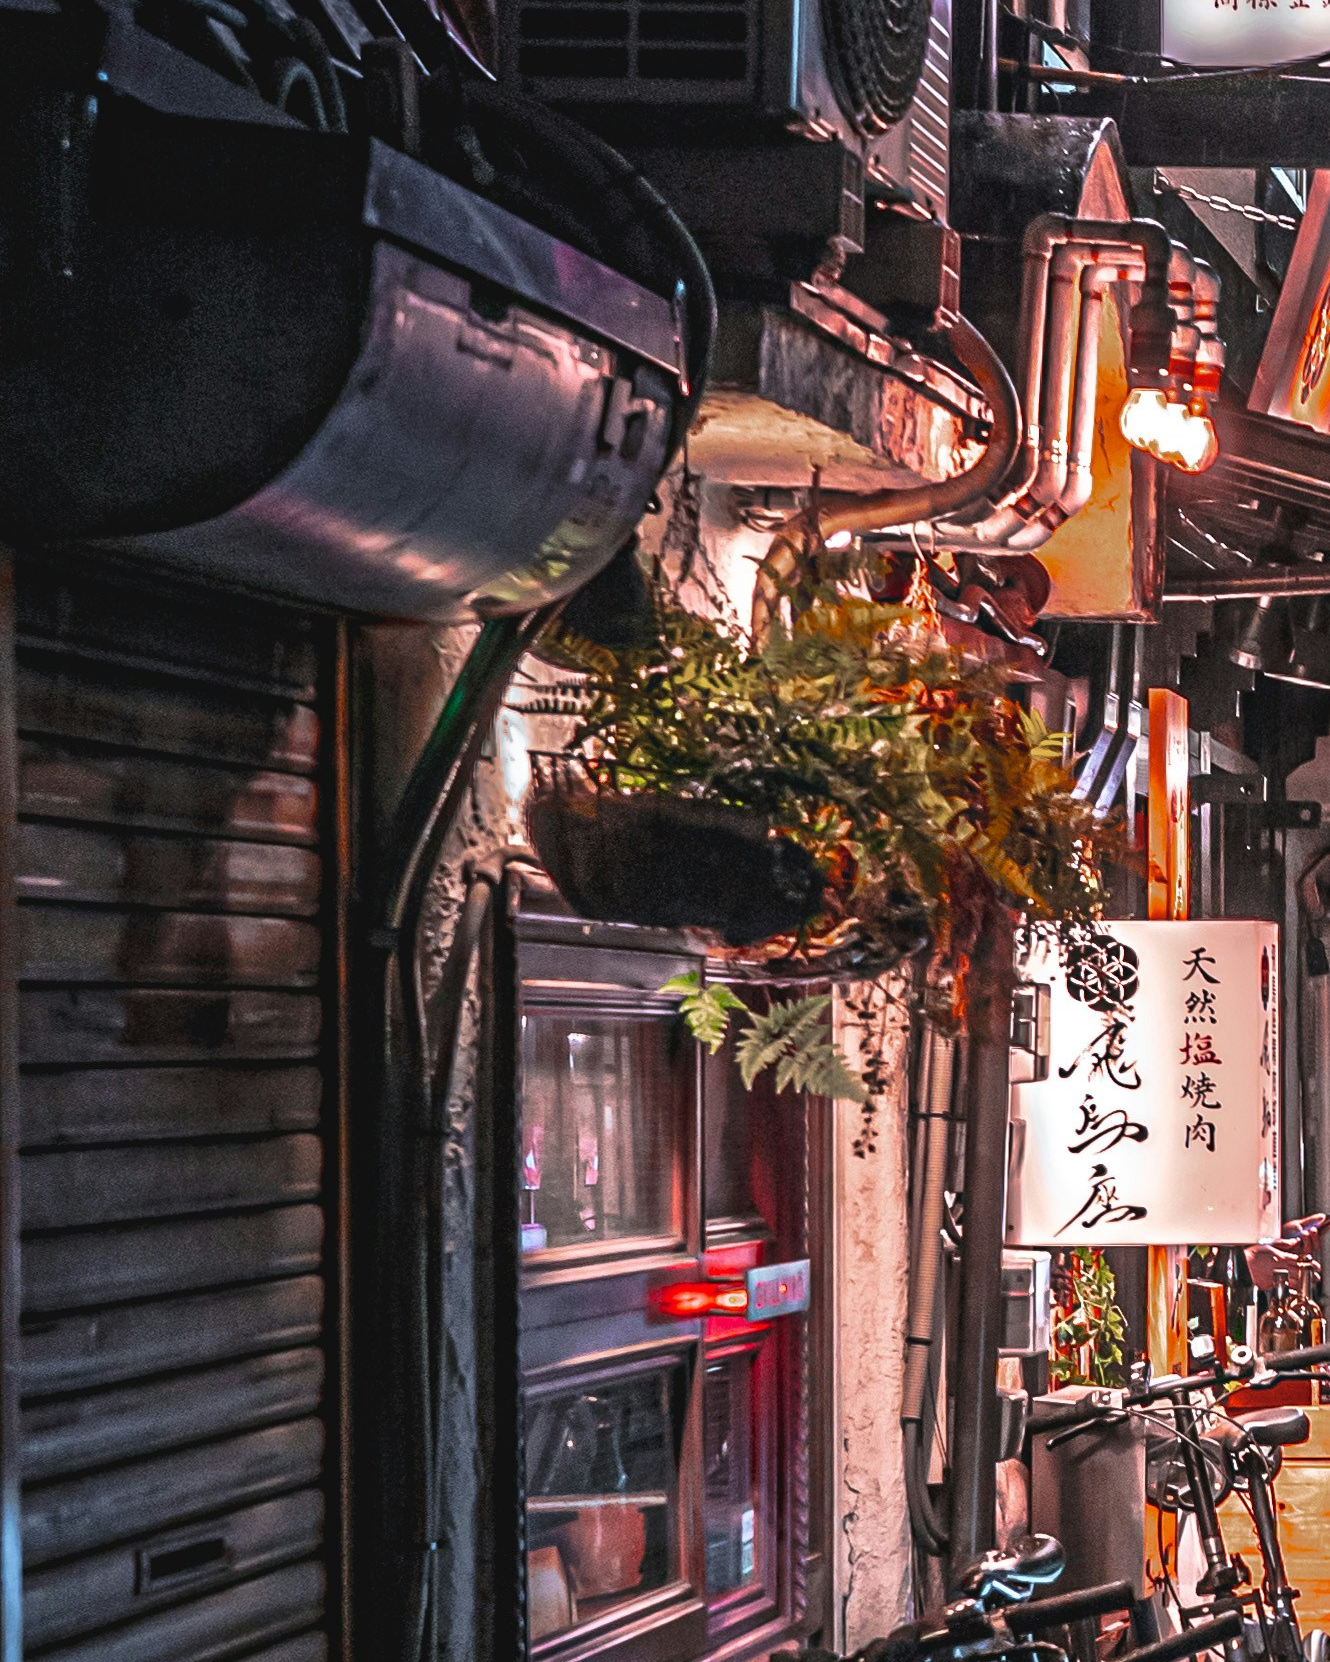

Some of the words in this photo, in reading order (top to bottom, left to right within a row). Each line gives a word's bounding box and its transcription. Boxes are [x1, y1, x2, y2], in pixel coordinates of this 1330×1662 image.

[1179, 946, 1223, 1153] 天然塩焼肉
